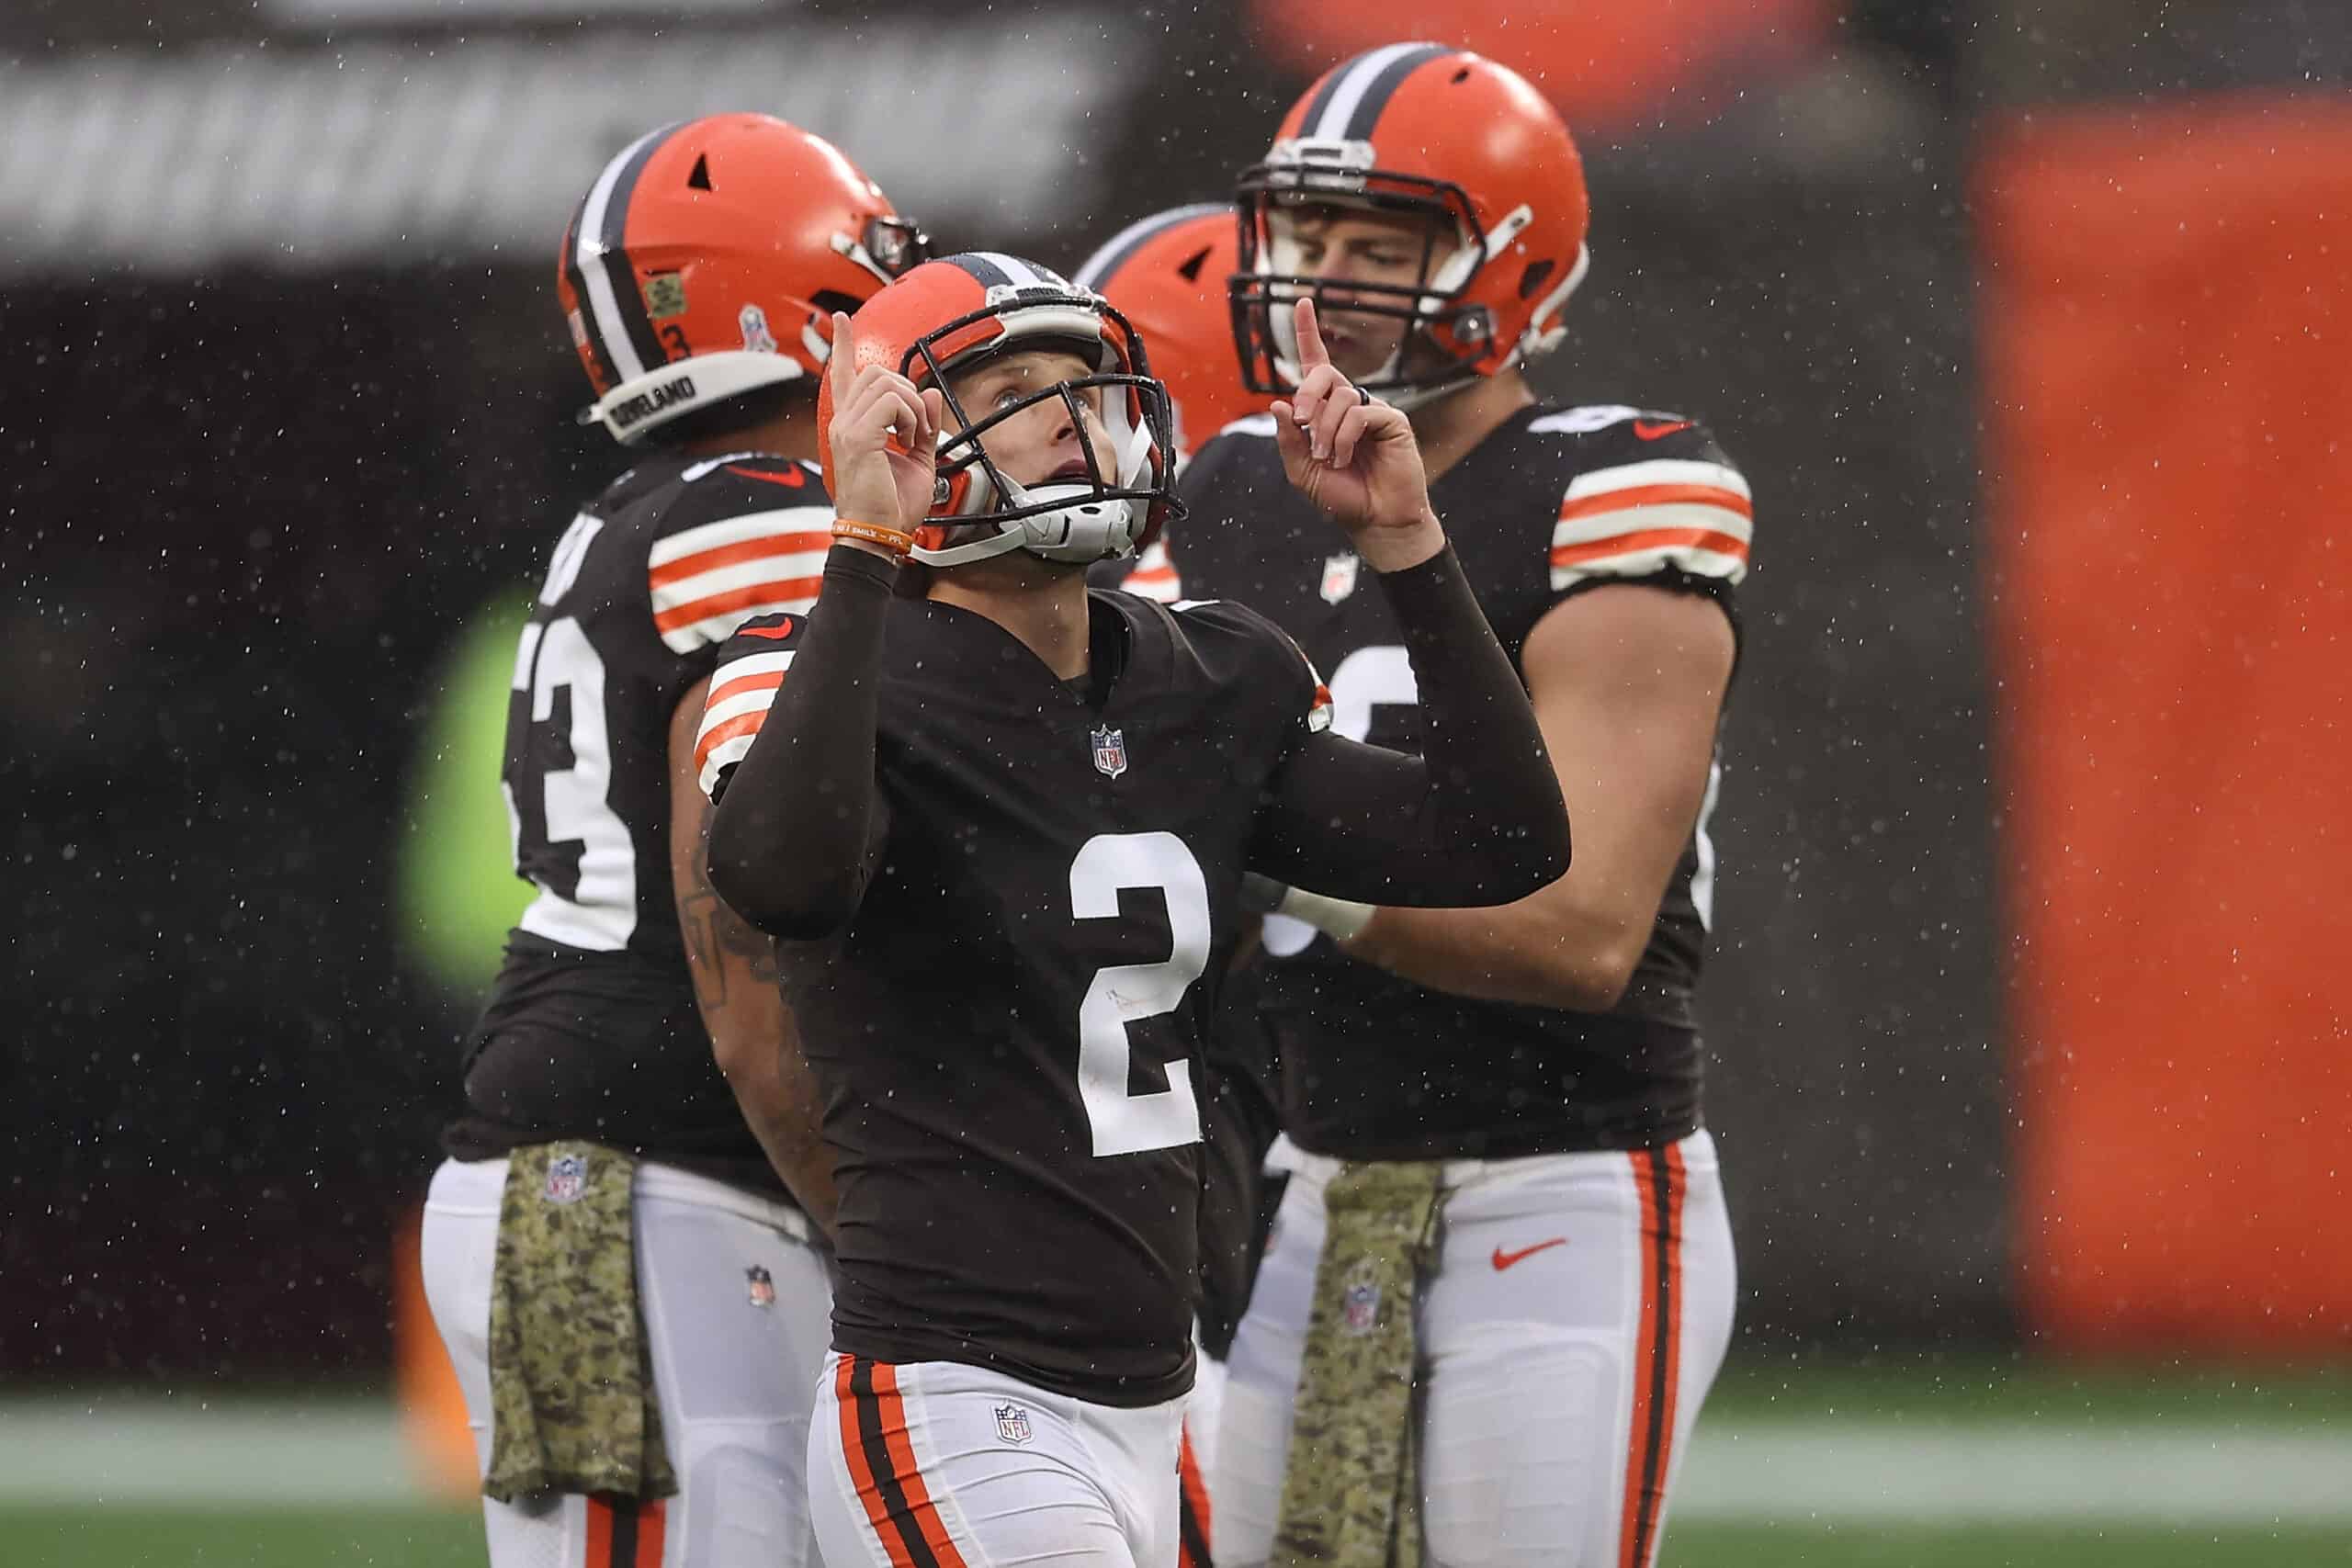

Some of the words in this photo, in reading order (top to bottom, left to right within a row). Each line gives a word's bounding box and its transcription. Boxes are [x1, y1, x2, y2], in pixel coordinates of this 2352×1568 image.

[502, 615, 638, 950] 3
[1098, 750, 1123, 770] NFL
[1069, 832, 1210, 1157] 2
